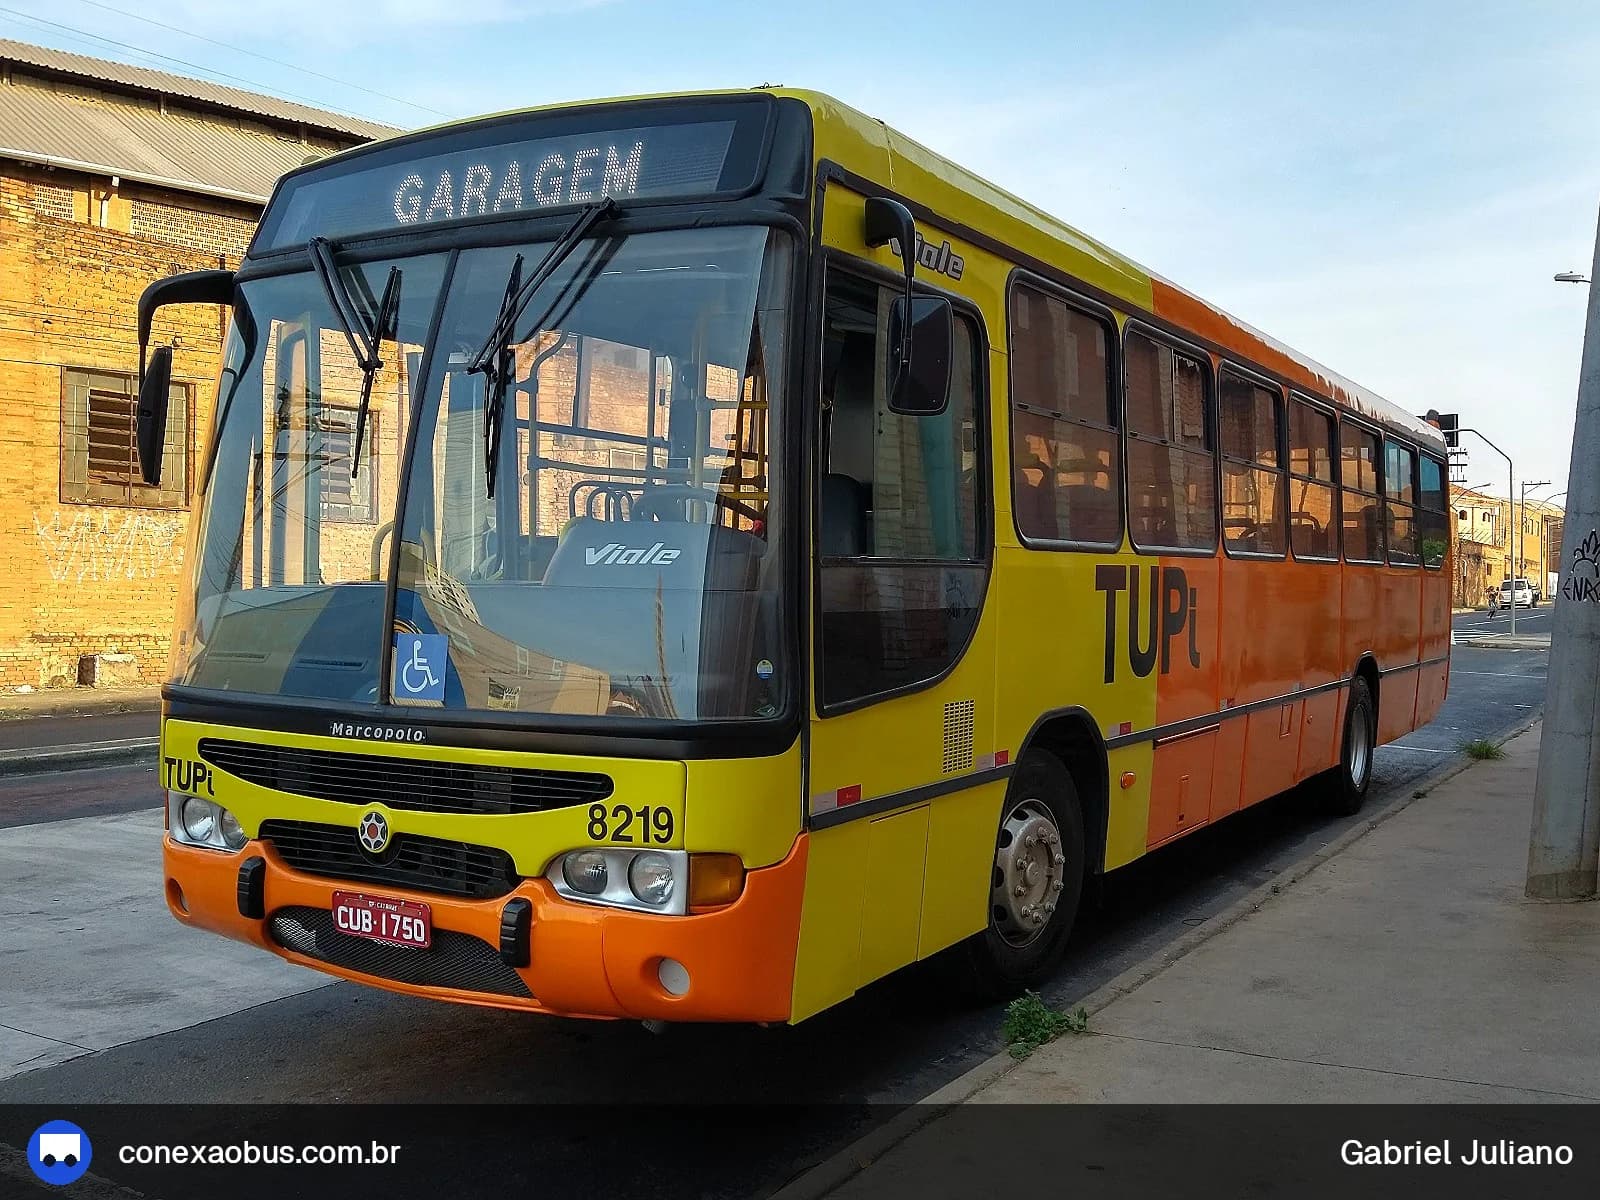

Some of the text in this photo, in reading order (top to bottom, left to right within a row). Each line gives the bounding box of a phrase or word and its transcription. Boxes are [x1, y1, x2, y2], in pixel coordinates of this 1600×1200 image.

[393, 141, 643, 224] GARAGEM
[890, 231, 964, 281] iale
[585, 542, 681, 565] Viale
[331, 722, 424, 742] Marcopolo
[587, 803, 674, 844] 8219
